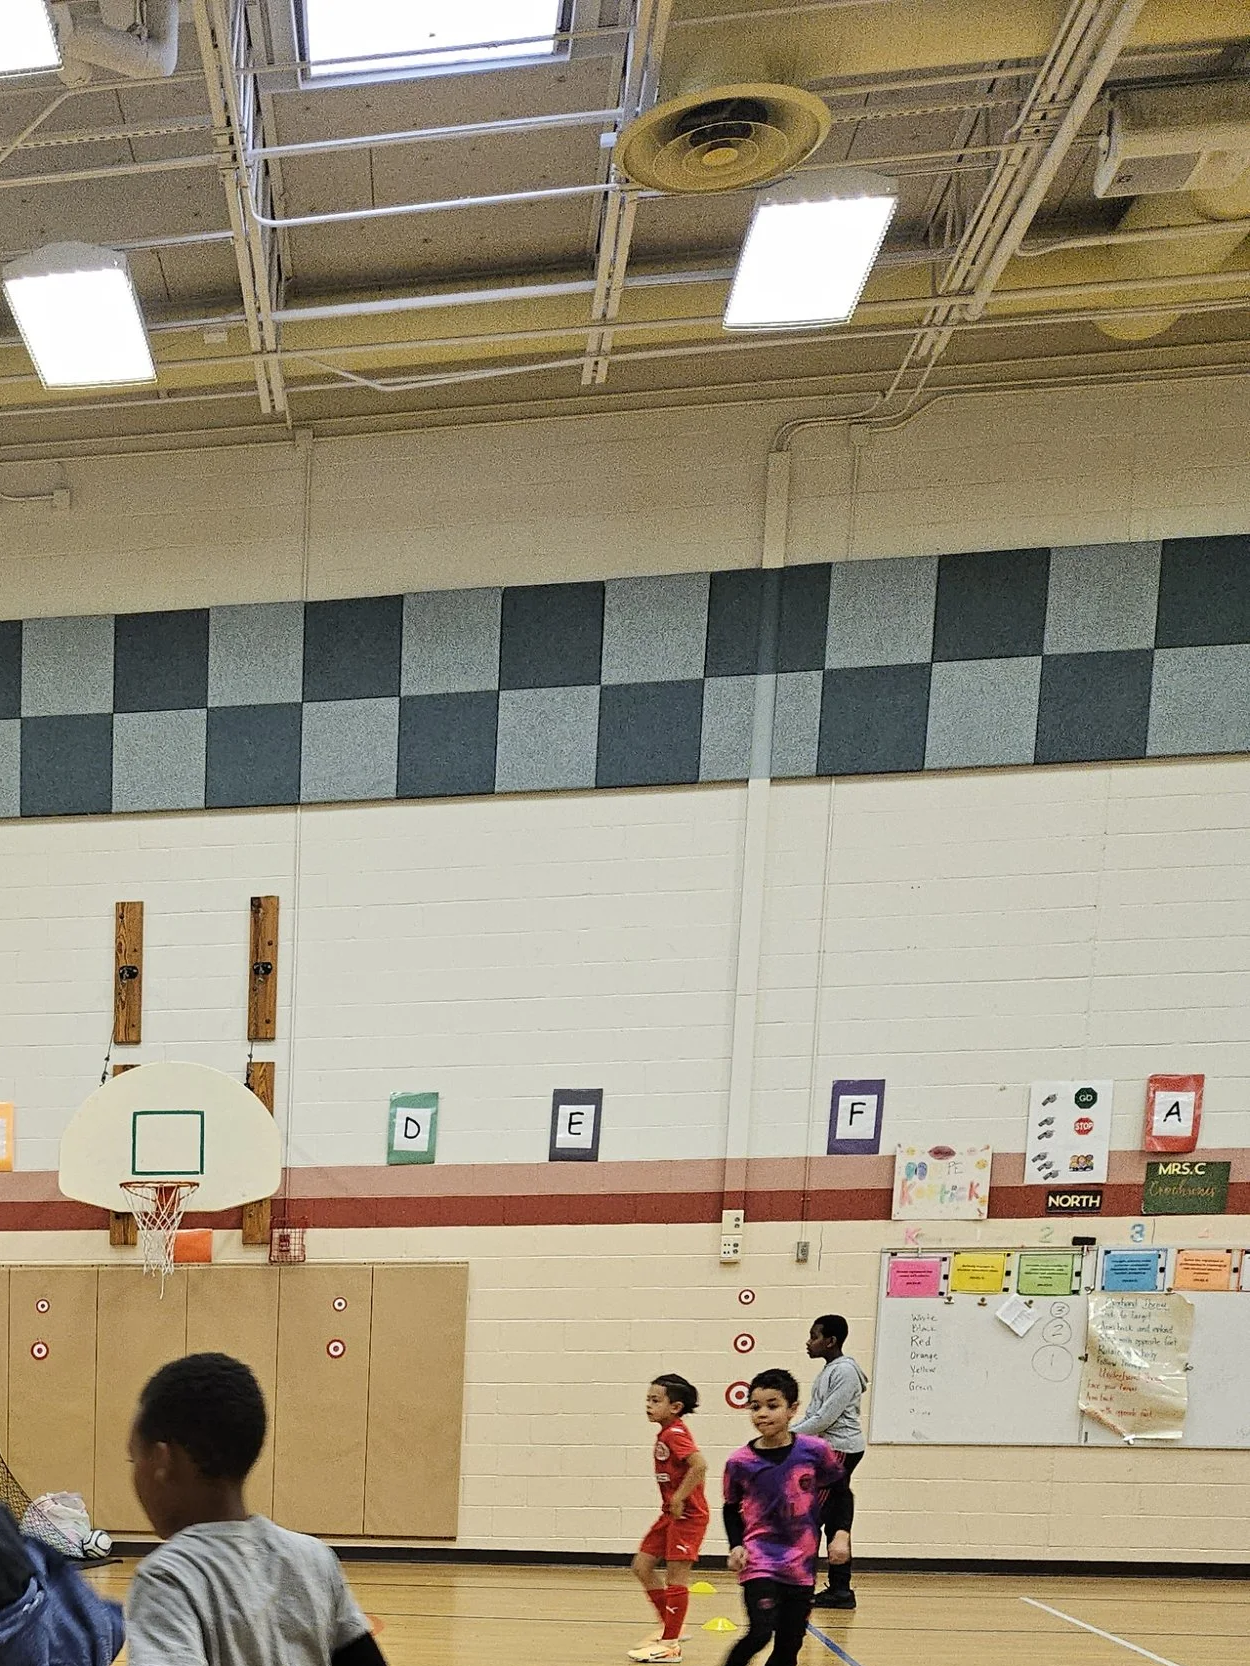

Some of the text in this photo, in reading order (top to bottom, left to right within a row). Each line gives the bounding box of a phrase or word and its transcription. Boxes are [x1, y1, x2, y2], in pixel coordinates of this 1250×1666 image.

[1079, 1094, 1093, 1102] GO
[849, 1102, 866, 1126] F
[1163, 1101, 1182, 1123] A
[404, 1116, 421, 1139] D
[568, 1111, 584, 1135] E
[1074, 1122, 1094, 1132] STOP
[1047, 1195, 1101, 1208] NORTH
[904, 1227, 921, 1246] K
[1039, 1226, 1054, 1243] 2
[1130, 1223, 1146, 1243] 3
[1052, 1324, 1064, 1337] 2
[910, 1335, 932, 1347] Red
[910, 1351, 939, 1363] Orange
[910, 1365, 937, 1378] Yellow
